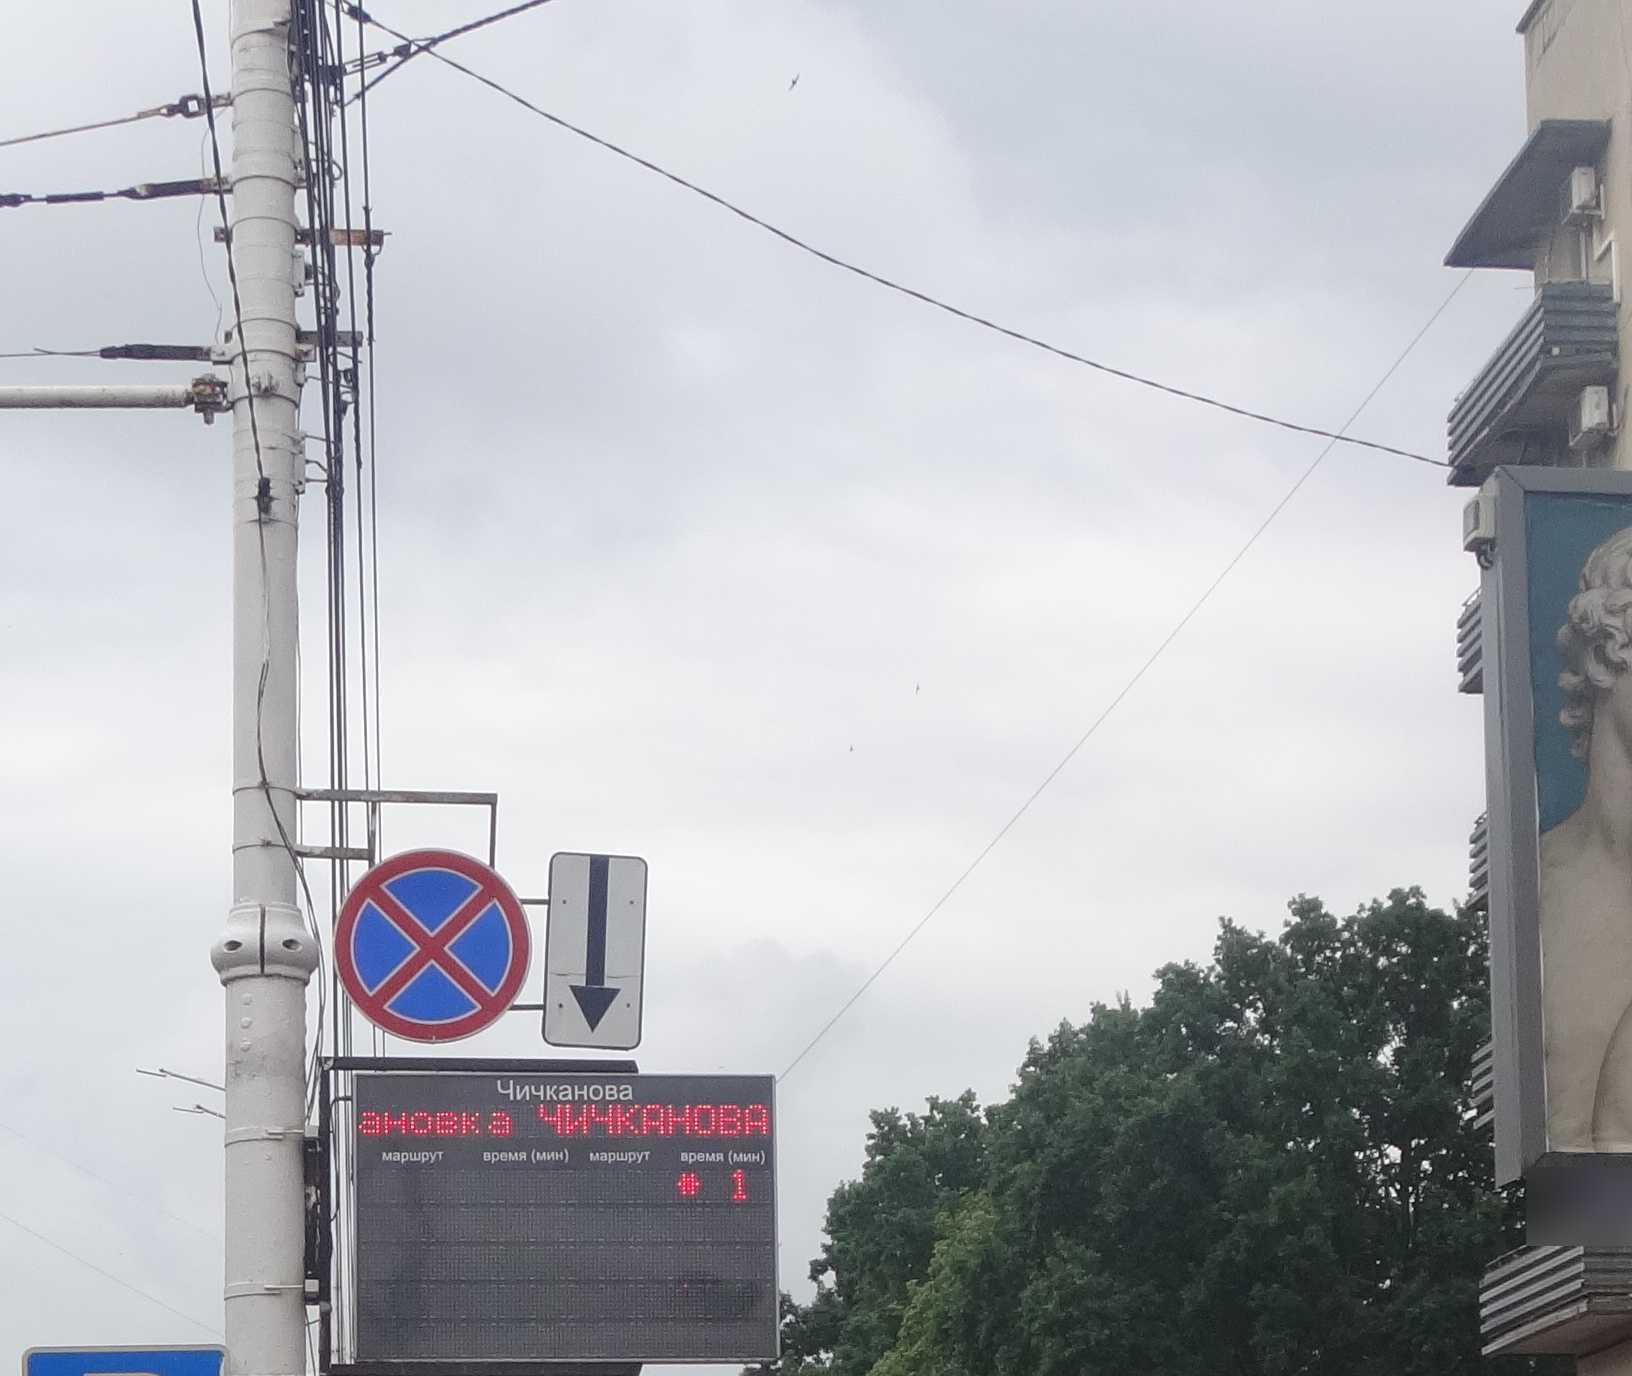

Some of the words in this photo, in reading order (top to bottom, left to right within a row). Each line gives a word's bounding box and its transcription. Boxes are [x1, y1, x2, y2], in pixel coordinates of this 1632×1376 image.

[496, 1080, 634, 1101] Чичканова
[536, 1103, 769, 1136] ЧИЧКАНОВА
[382, 1151, 444, 1164] маршрут
[483, 1151, 528, 1164] время
[531, 1149, 569, 1164] (мин)
[589, 1151, 651, 1164] маршрут
[680, 1152, 724, 1165] время
[727, 1150, 766, 1165] (мин)
[733, 1169, 747, 1201] 1
